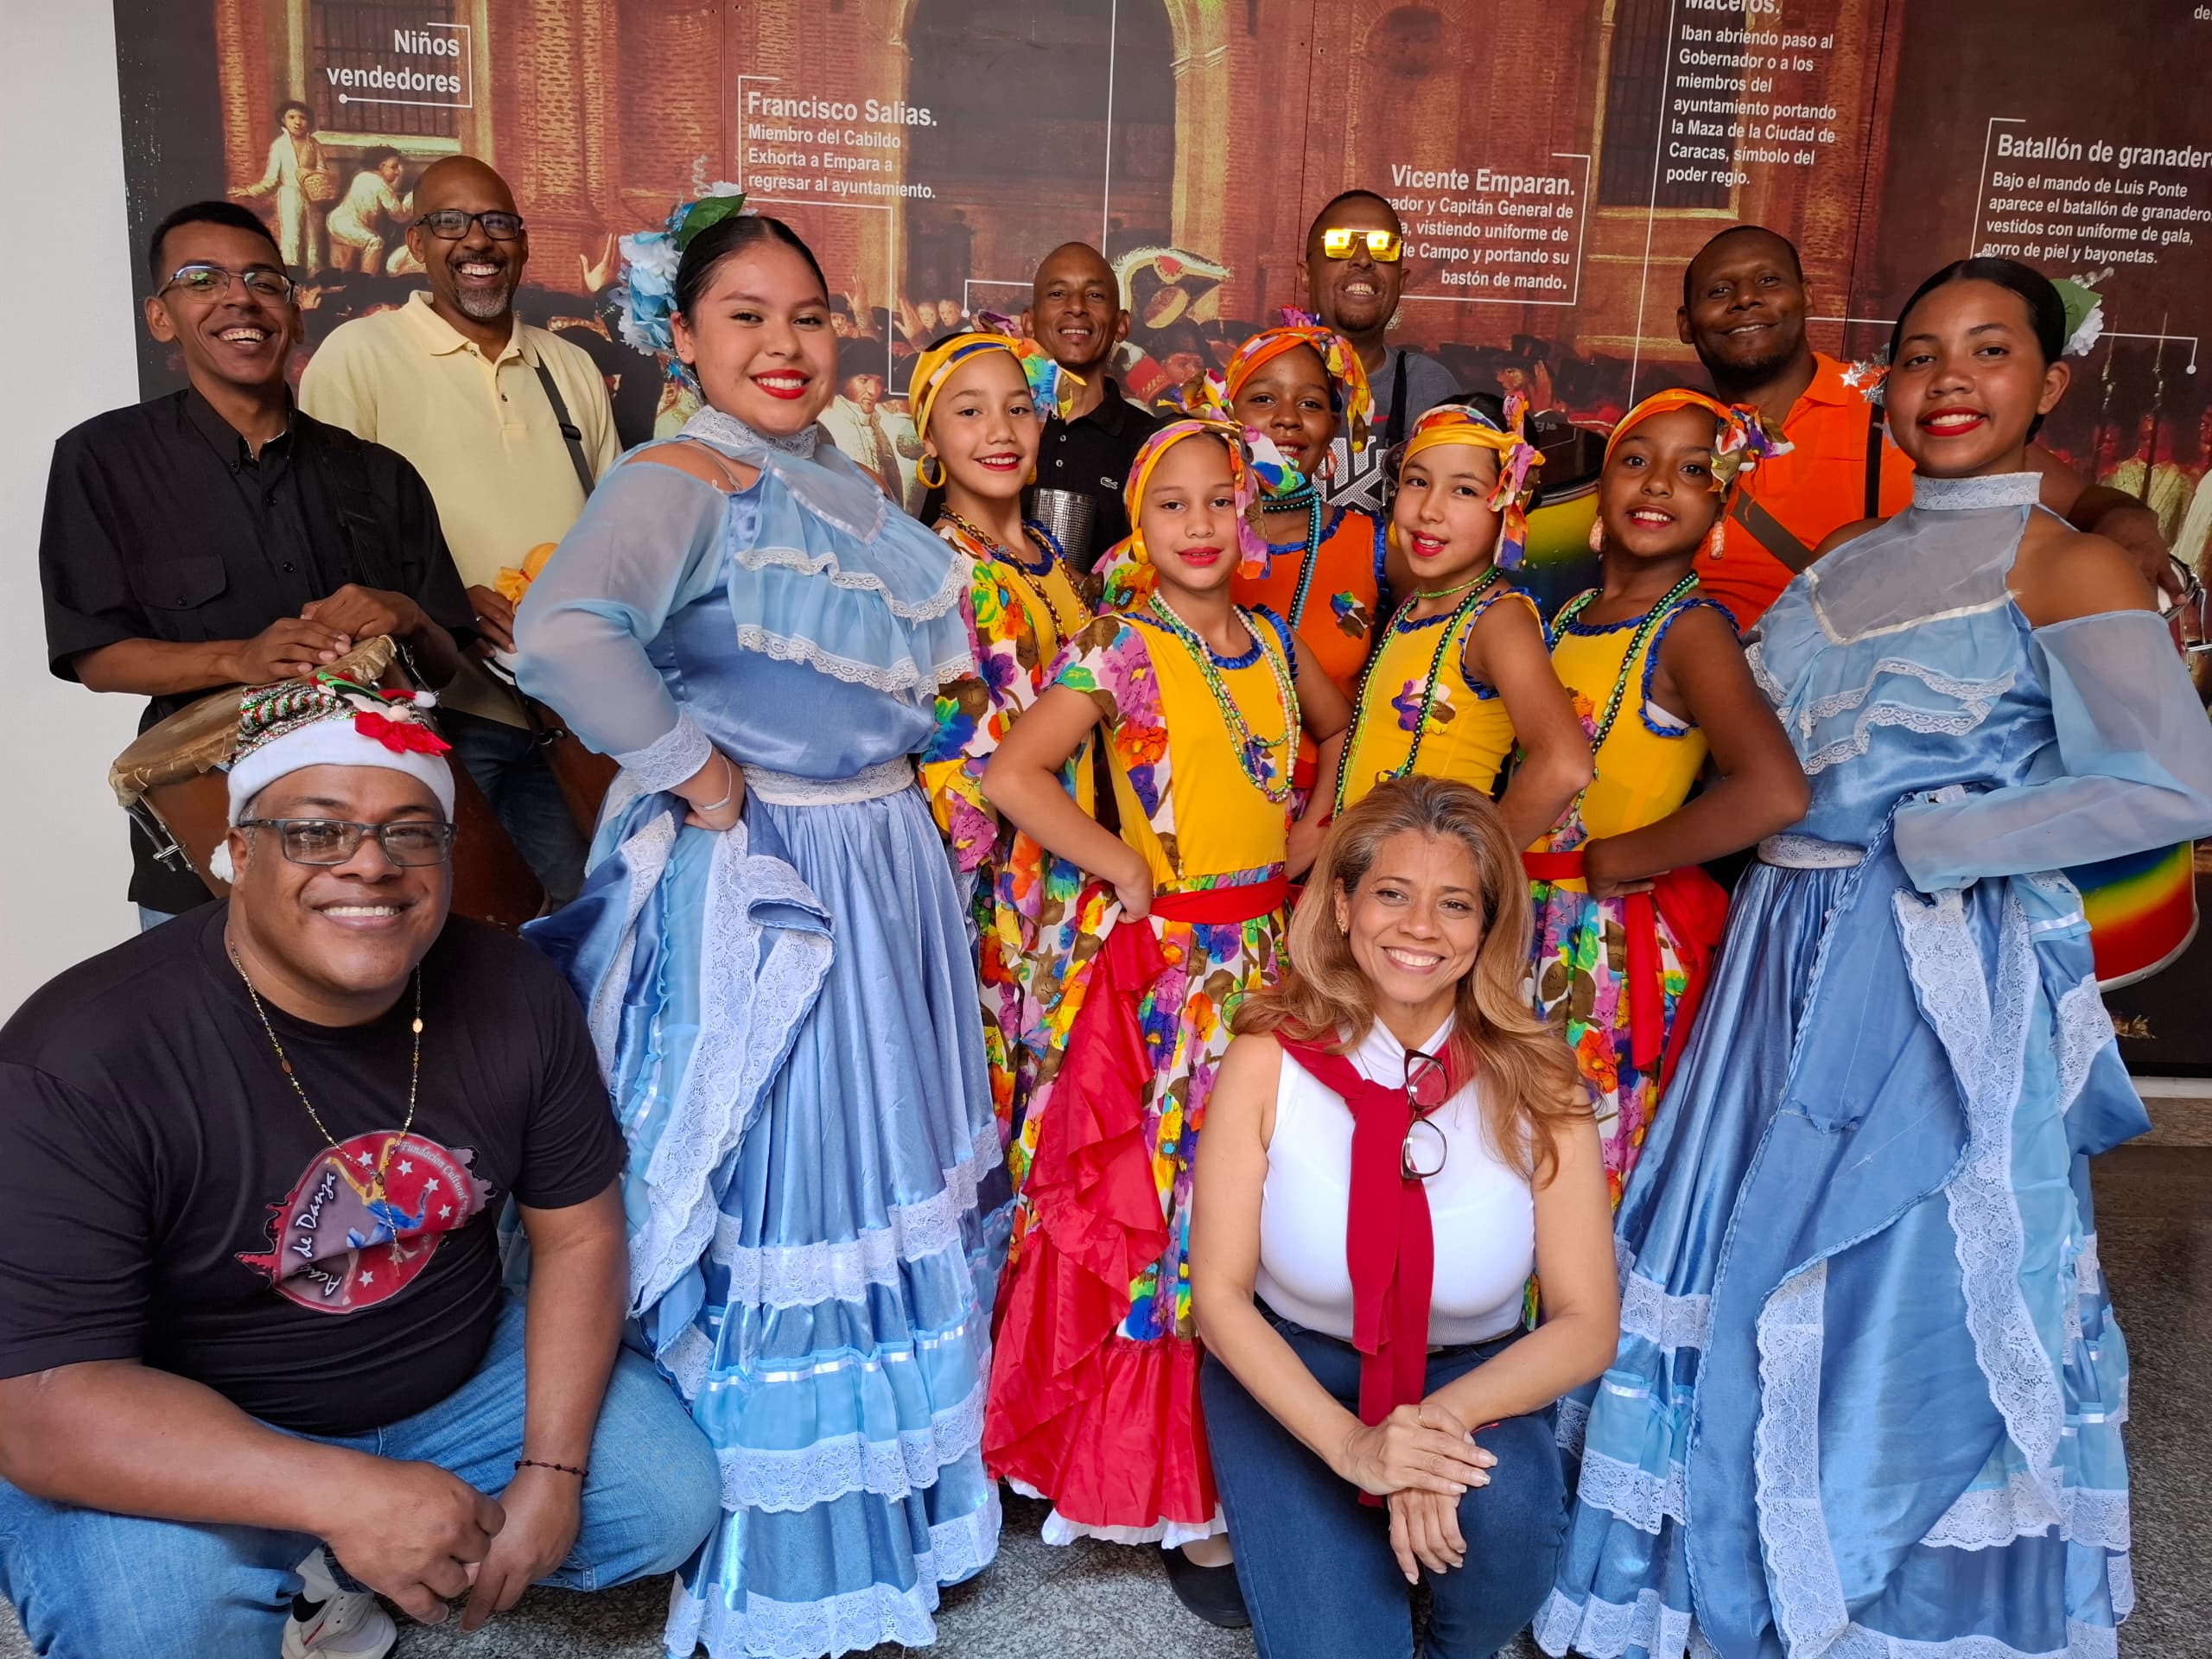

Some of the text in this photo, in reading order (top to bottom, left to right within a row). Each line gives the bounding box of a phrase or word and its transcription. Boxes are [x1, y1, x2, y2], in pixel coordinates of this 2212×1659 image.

[2194, 4, 2212, 20] de
[394, 29, 460, 57] Niños
[1681, 24, 1834, 50] Iban abriendo paso al
[1679, 48, 1814, 72] Gobernador o a los
[326, 65, 461, 93] vendedores
[1676, 73, 1772, 92] miembros del
[747, 91, 938, 127] Francisco Salias.
[1673, 98, 1837, 120] ayuntamiento portando
[748, 123, 901, 149] Miembro del Cabildo
[1671, 119, 1835, 143] la Maza de la Ciudad de
[748, 148, 893, 173] Exhorta a Empara a
[1669, 142, 1815, 166] Caracas, símbolo del
[1997, 133, 2212, 169] Batallón de granader
[748, 175, 937, 199] regresar al ayuntamiento.
[1391, 163, 1575, 198] Vicente Emparan.
[1666, 166, 1751, 188] poder regio.
[1993, 171, 2188, 197] Bajo el mando de Luis Ponte
[1427, 200, 1436, 216] y
[1440, 196, 1493, 217] Capitán
[1497, 200, 1552, 218] General
[1556, 202, 1573, 219] de
[1989, 197, 2212, 222] aparece el batallón de granadero
[1416, 219, 1481, 238] vistiendo
[1484, 223, 1548, 241] uniforme
[1551, 226, 1569, 242] de
[1986, 218, 2194, 245] vestidos con uniforme de gala,
[1420, 242, 1469, 263] Campo
[1472, 248, 1482, 264] y
[1484, 247, 1548, 264] portando
[1552, 251, 1569, 265] su
[2024, 242, 2041, 257] de
[2044, 244, 2069, 261] piel
[2071, 248, 2082, 264] y
[2084, 245, 2158, 264] bayonetas.
[1441, 269, 1567, 289] bastón de mando.
[296, 1172, 336, 1230] Danza
